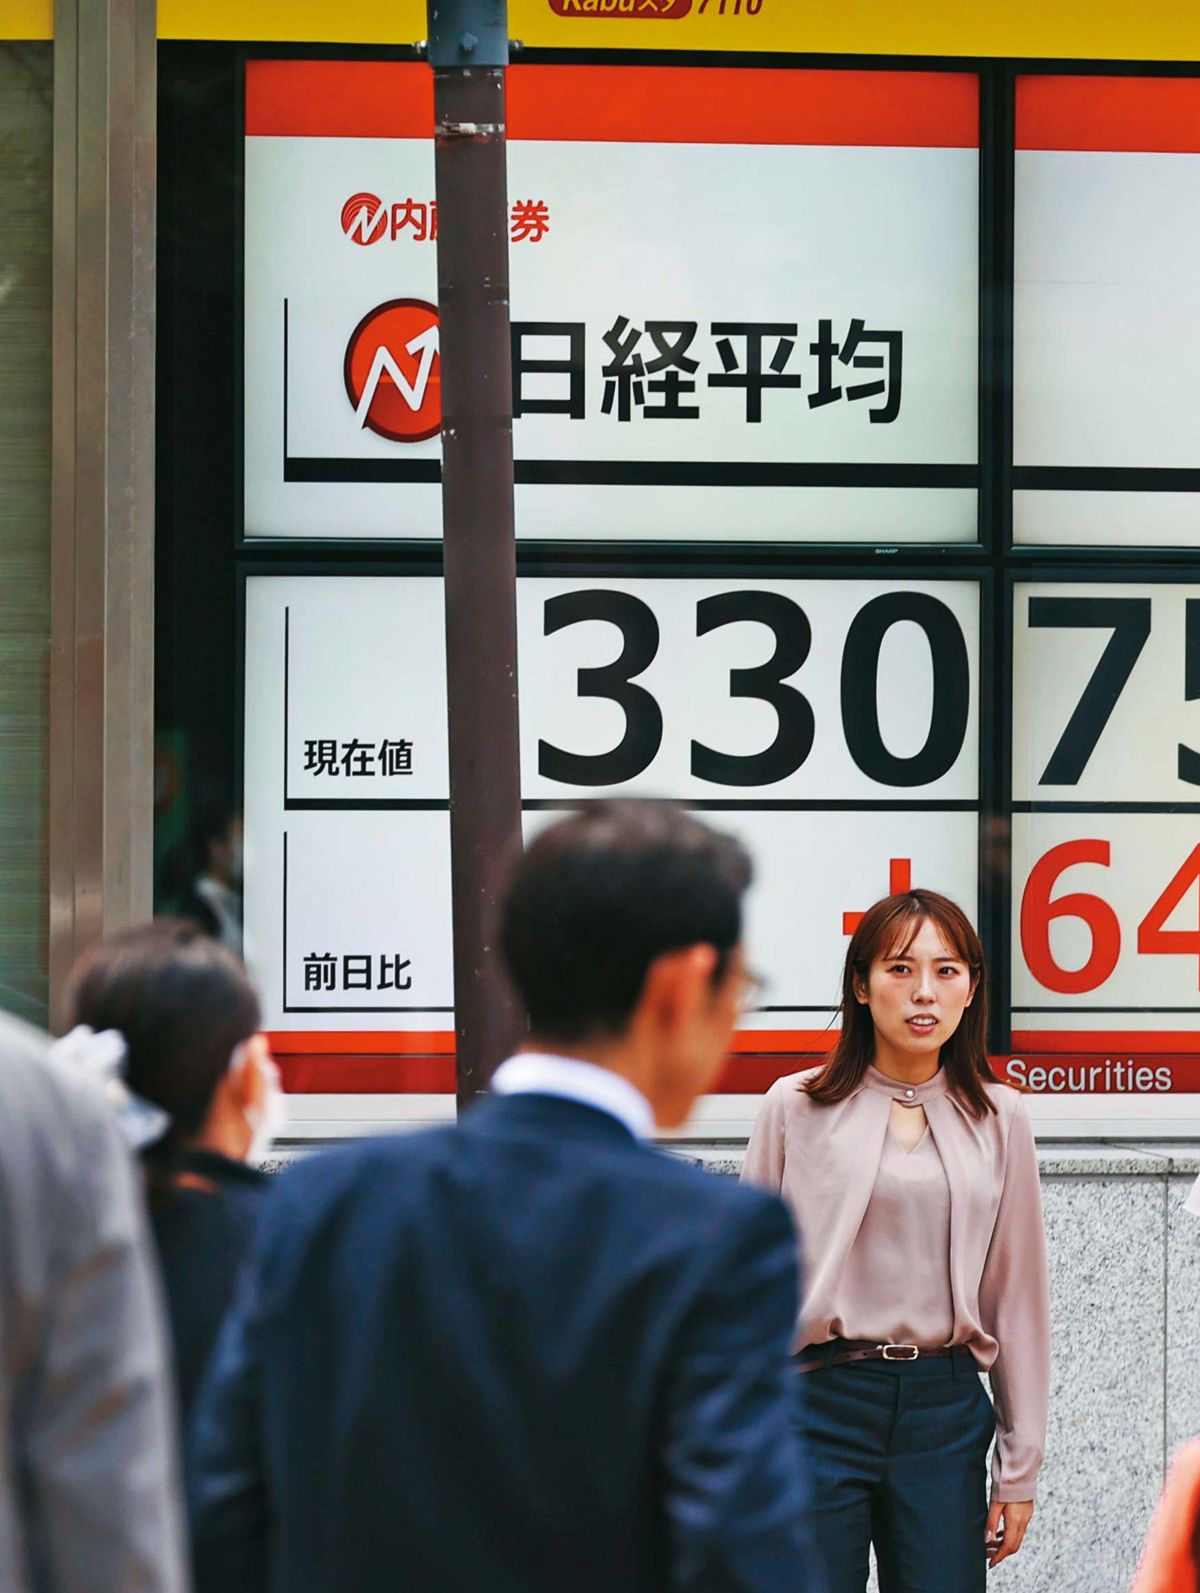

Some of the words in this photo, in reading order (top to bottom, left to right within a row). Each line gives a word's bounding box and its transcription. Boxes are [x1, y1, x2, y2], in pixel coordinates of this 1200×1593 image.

[391, 197, 550, 244] 内券
[510, 314, 904, 424] 日経平均
[303, 738, 414, 777] 現在値
[302, 951, 413, 992] 前日比
[1005, 1058, 1173, 1092] Securities
